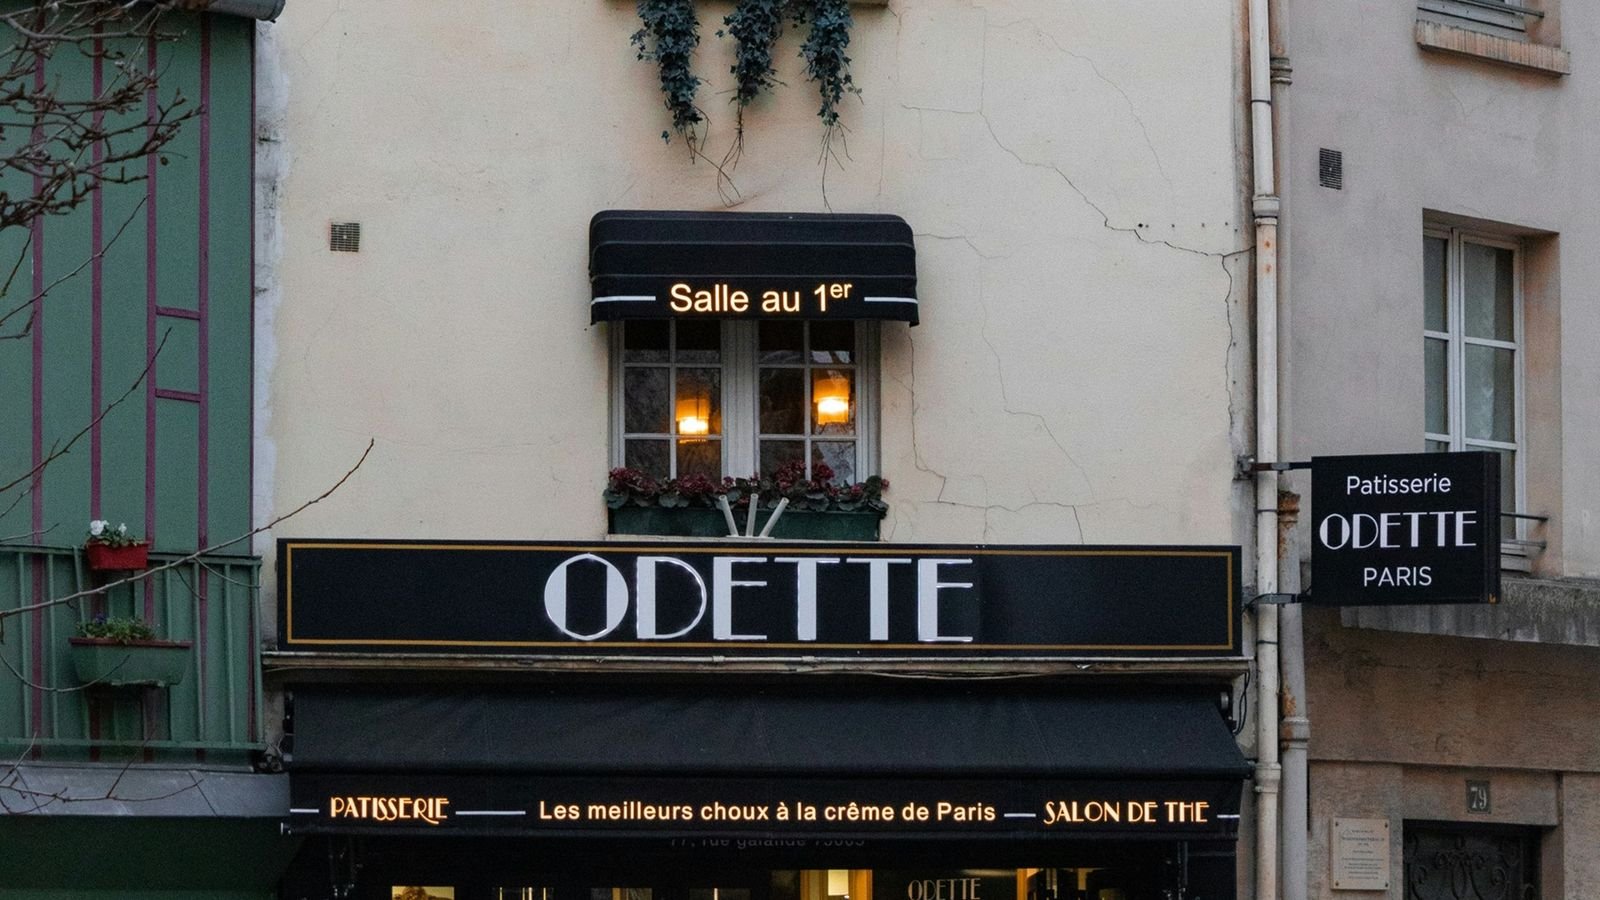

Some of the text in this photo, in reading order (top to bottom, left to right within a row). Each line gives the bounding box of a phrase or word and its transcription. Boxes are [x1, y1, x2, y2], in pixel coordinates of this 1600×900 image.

[670, 284, 852, 312] Salle au 1er
[1347, 473, 1451, 495] Patisserie
[1320, 510, 1477, 550] ODETTE
[1364, 566, 1432, 587] PARIS
[544, 553, 974, 643] ODETTE
[1470, 786, 1487, 809] 79
[330, 797, 449, 825] PATISSERIE
[540, 801, 996, 821] Les meilleurs choux à la crême de Paris
[1044, 801, 1210, 825] SALON DE THE
[907, 877, 982, 900] ODETTE
